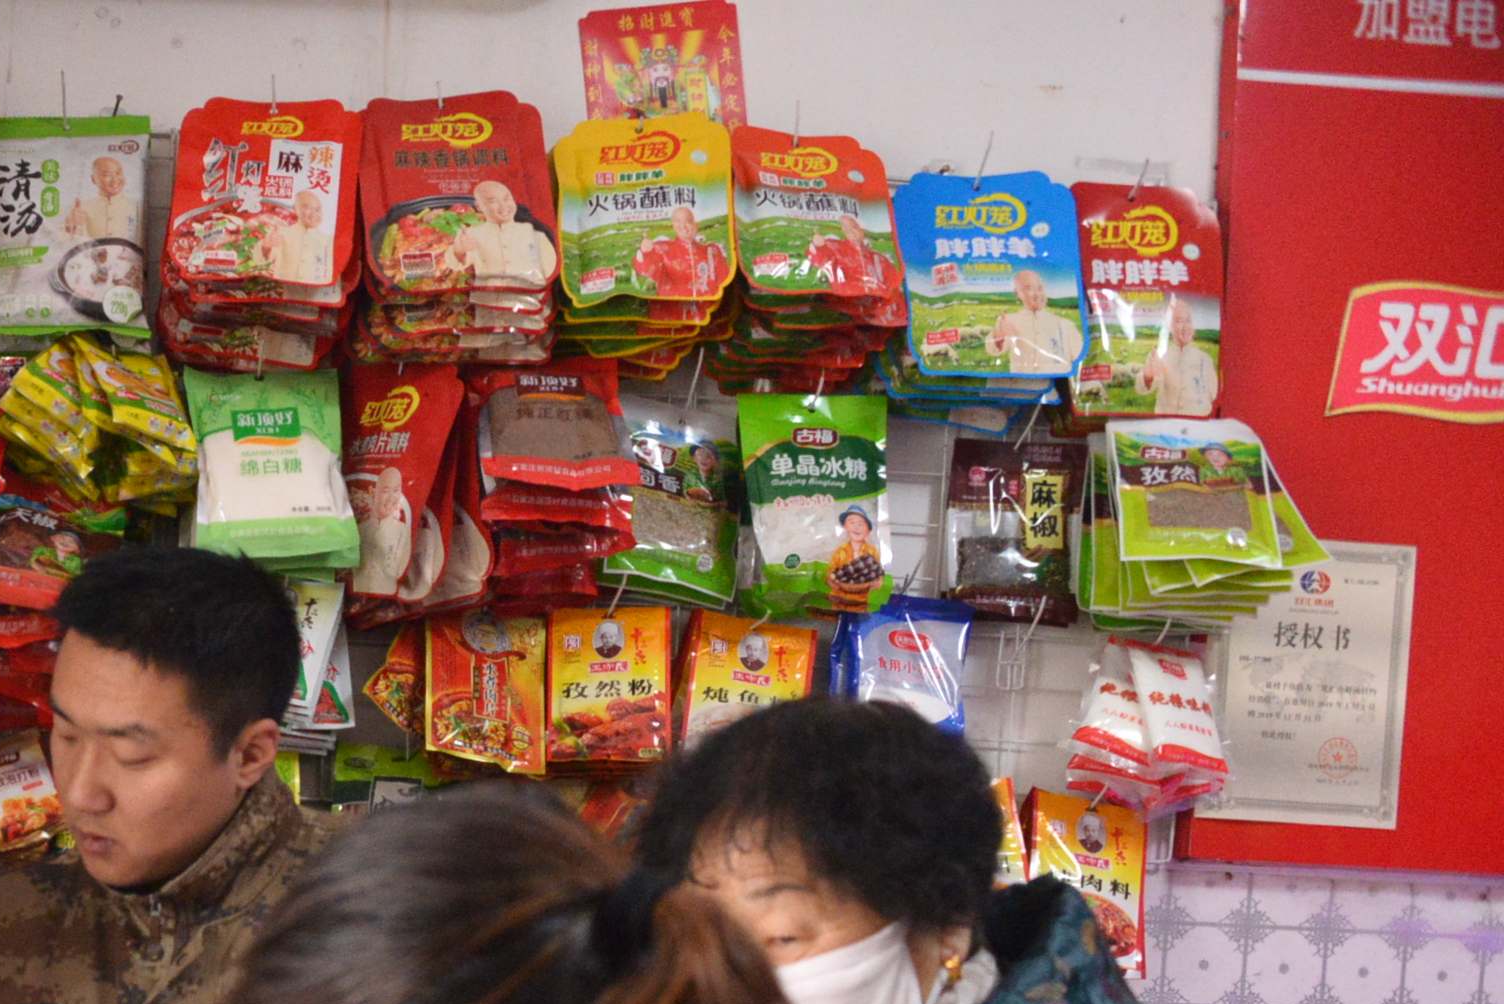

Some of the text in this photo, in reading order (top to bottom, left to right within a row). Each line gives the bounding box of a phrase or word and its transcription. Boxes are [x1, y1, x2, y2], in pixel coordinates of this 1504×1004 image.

[1355, 0, 1501, 48] 加盟电
[599, 137, 674, 166] 红灯笼
[588, 186, 697, 216] 火锅蘸料
[935, 201, 1020, 230] 红灯笼
[1091, 215, 1172, 249] 红灯笼
[240, 458, 302, 477] 绵白糖
[770, 453, 867, 481] 单晶冰糖
[1141, 465, 1197, 485] 孜然
[1031, 480, 1058, 538] 麻椒
[1273, 621, 1351, 651] 授权书
[562, 679, 653, 699] 孜然粉
